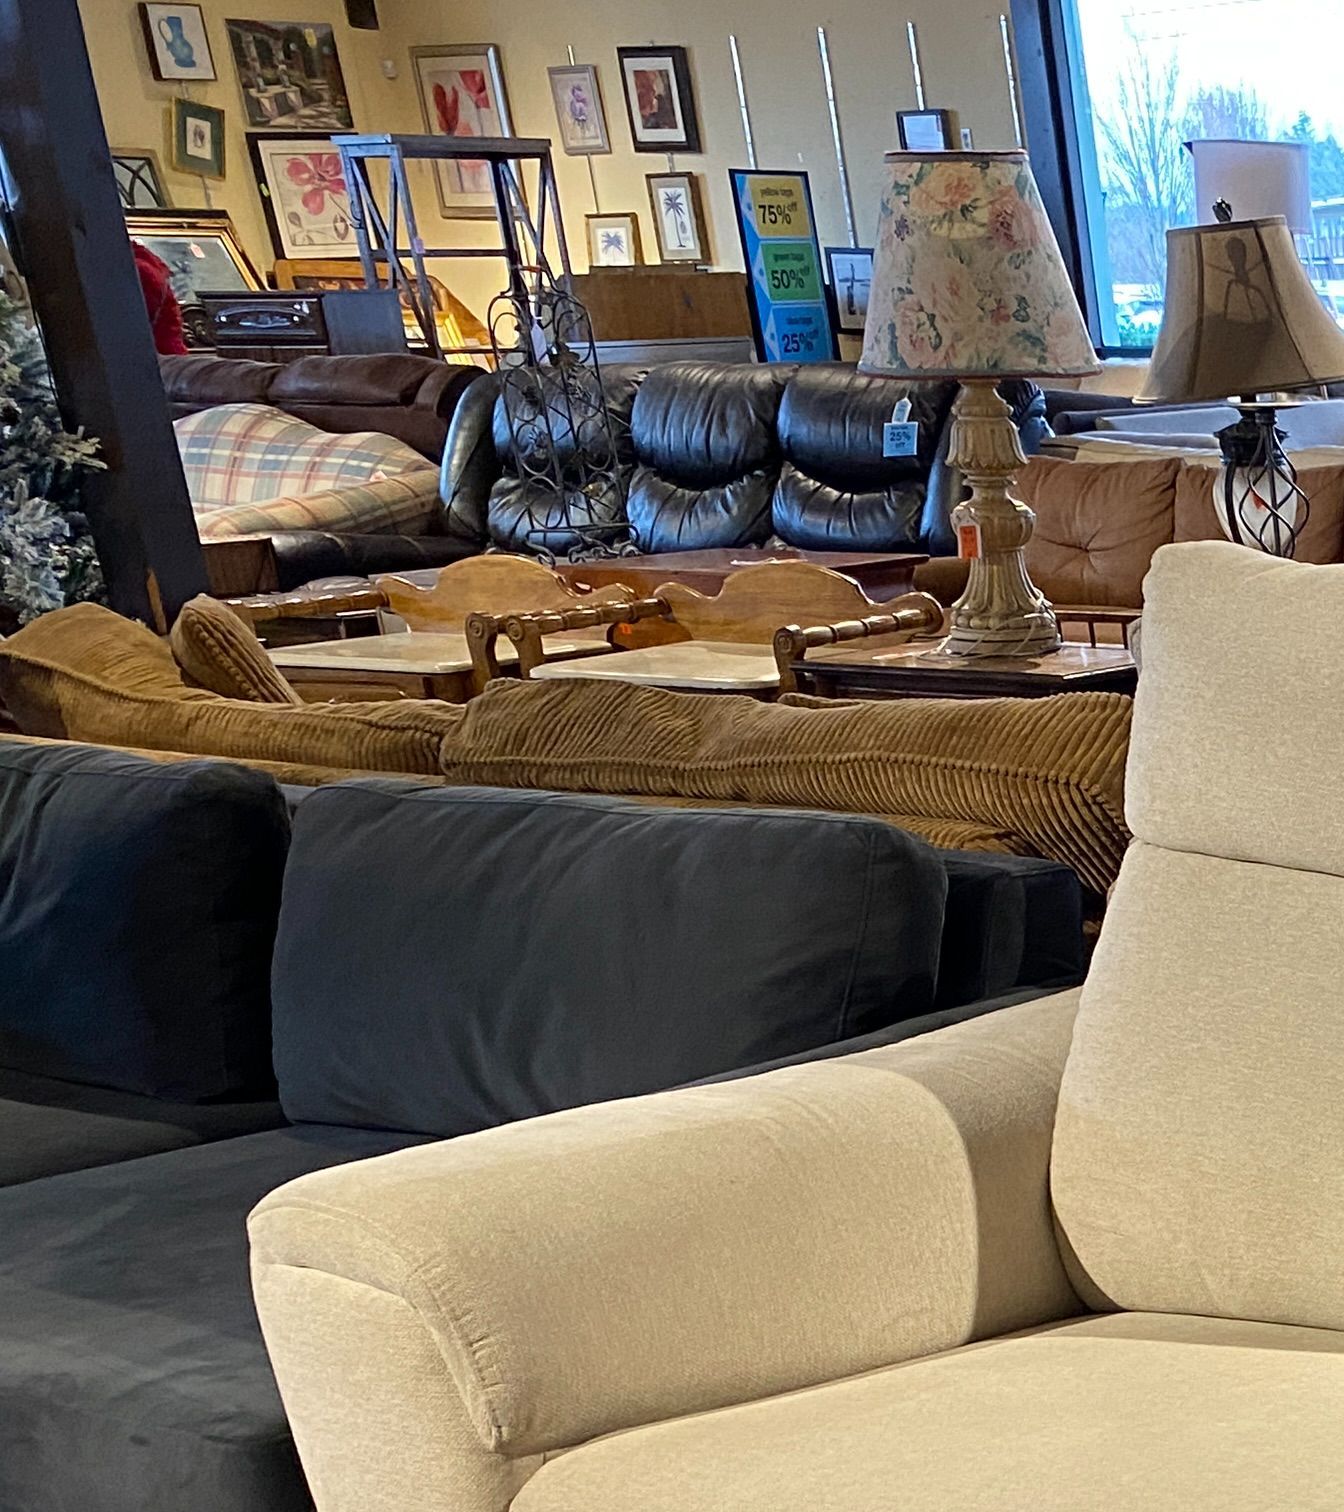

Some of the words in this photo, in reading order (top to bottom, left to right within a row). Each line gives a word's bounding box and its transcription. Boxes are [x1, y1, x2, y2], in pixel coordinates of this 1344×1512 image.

[758, 204, 792, 225] 75%
[771, 269, 805, 289] 50%
[782, 332, 814, 353] 25%
[890, 431, 911, 442] 25%
